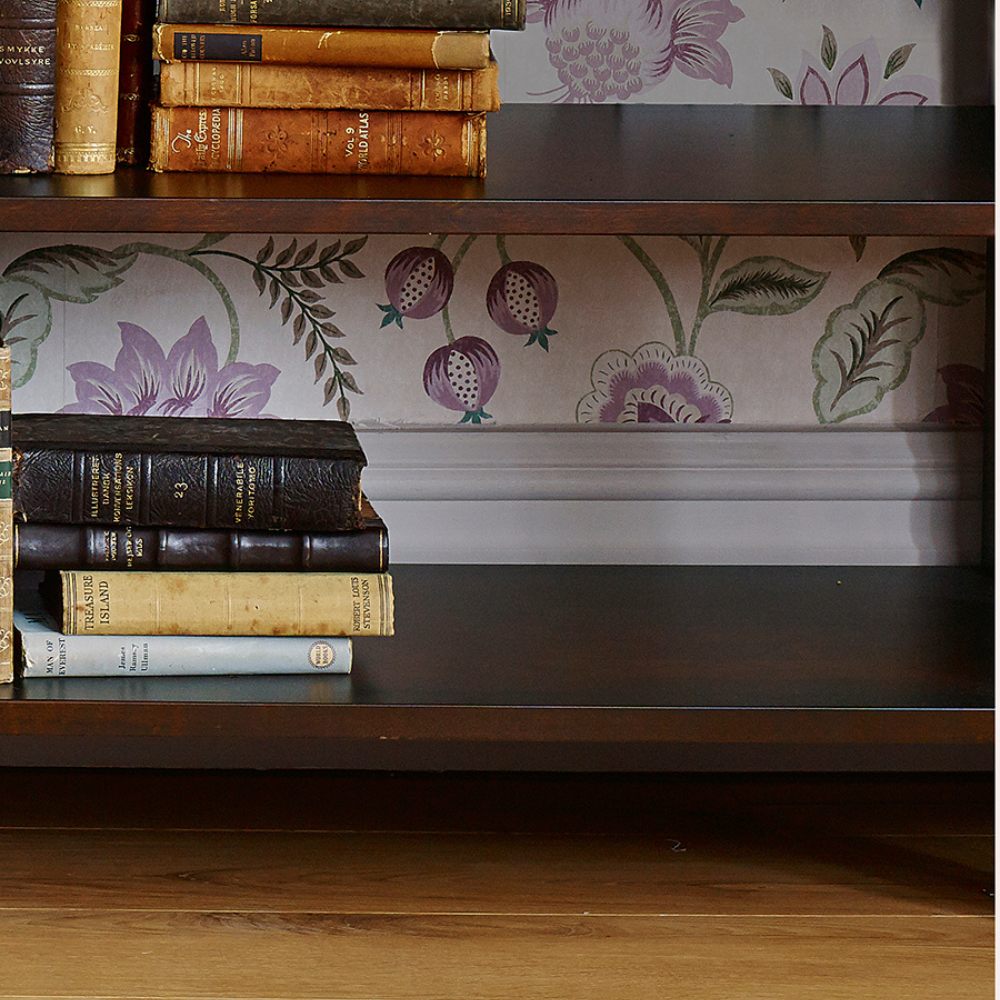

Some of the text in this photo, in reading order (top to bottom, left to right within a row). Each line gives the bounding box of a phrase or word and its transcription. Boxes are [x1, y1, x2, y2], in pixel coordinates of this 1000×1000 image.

[171, 129, 192, 153] The
[345, 127, 355, 158] VOL 9
[358, 112, 369, 140] ATLAS
[102, 472, 111, 506] DANSK
[113, 453, 123, 523] KONVERSATIONS
[125, 466, 134, 510] LEKSIKON
[173, 482, 189, 499] 23
[234, 461, 244, 524] VENERABILE
[247, 466, 256, 520] YORITOMO
[83, 574, 94, 631] TREASURE
[99, 580, 110, 625] ISLAND
[351, 577, 360, 632] ROBERT LOUIS
[361, 579, 371, 630] STEVENSON
[46, 640, 54, 674] MAN OF
[58, 637, 66, 675] EVEREST
[129, 643, 139, 671] Ramsey
[141, 642, 149, 671] Ullman
